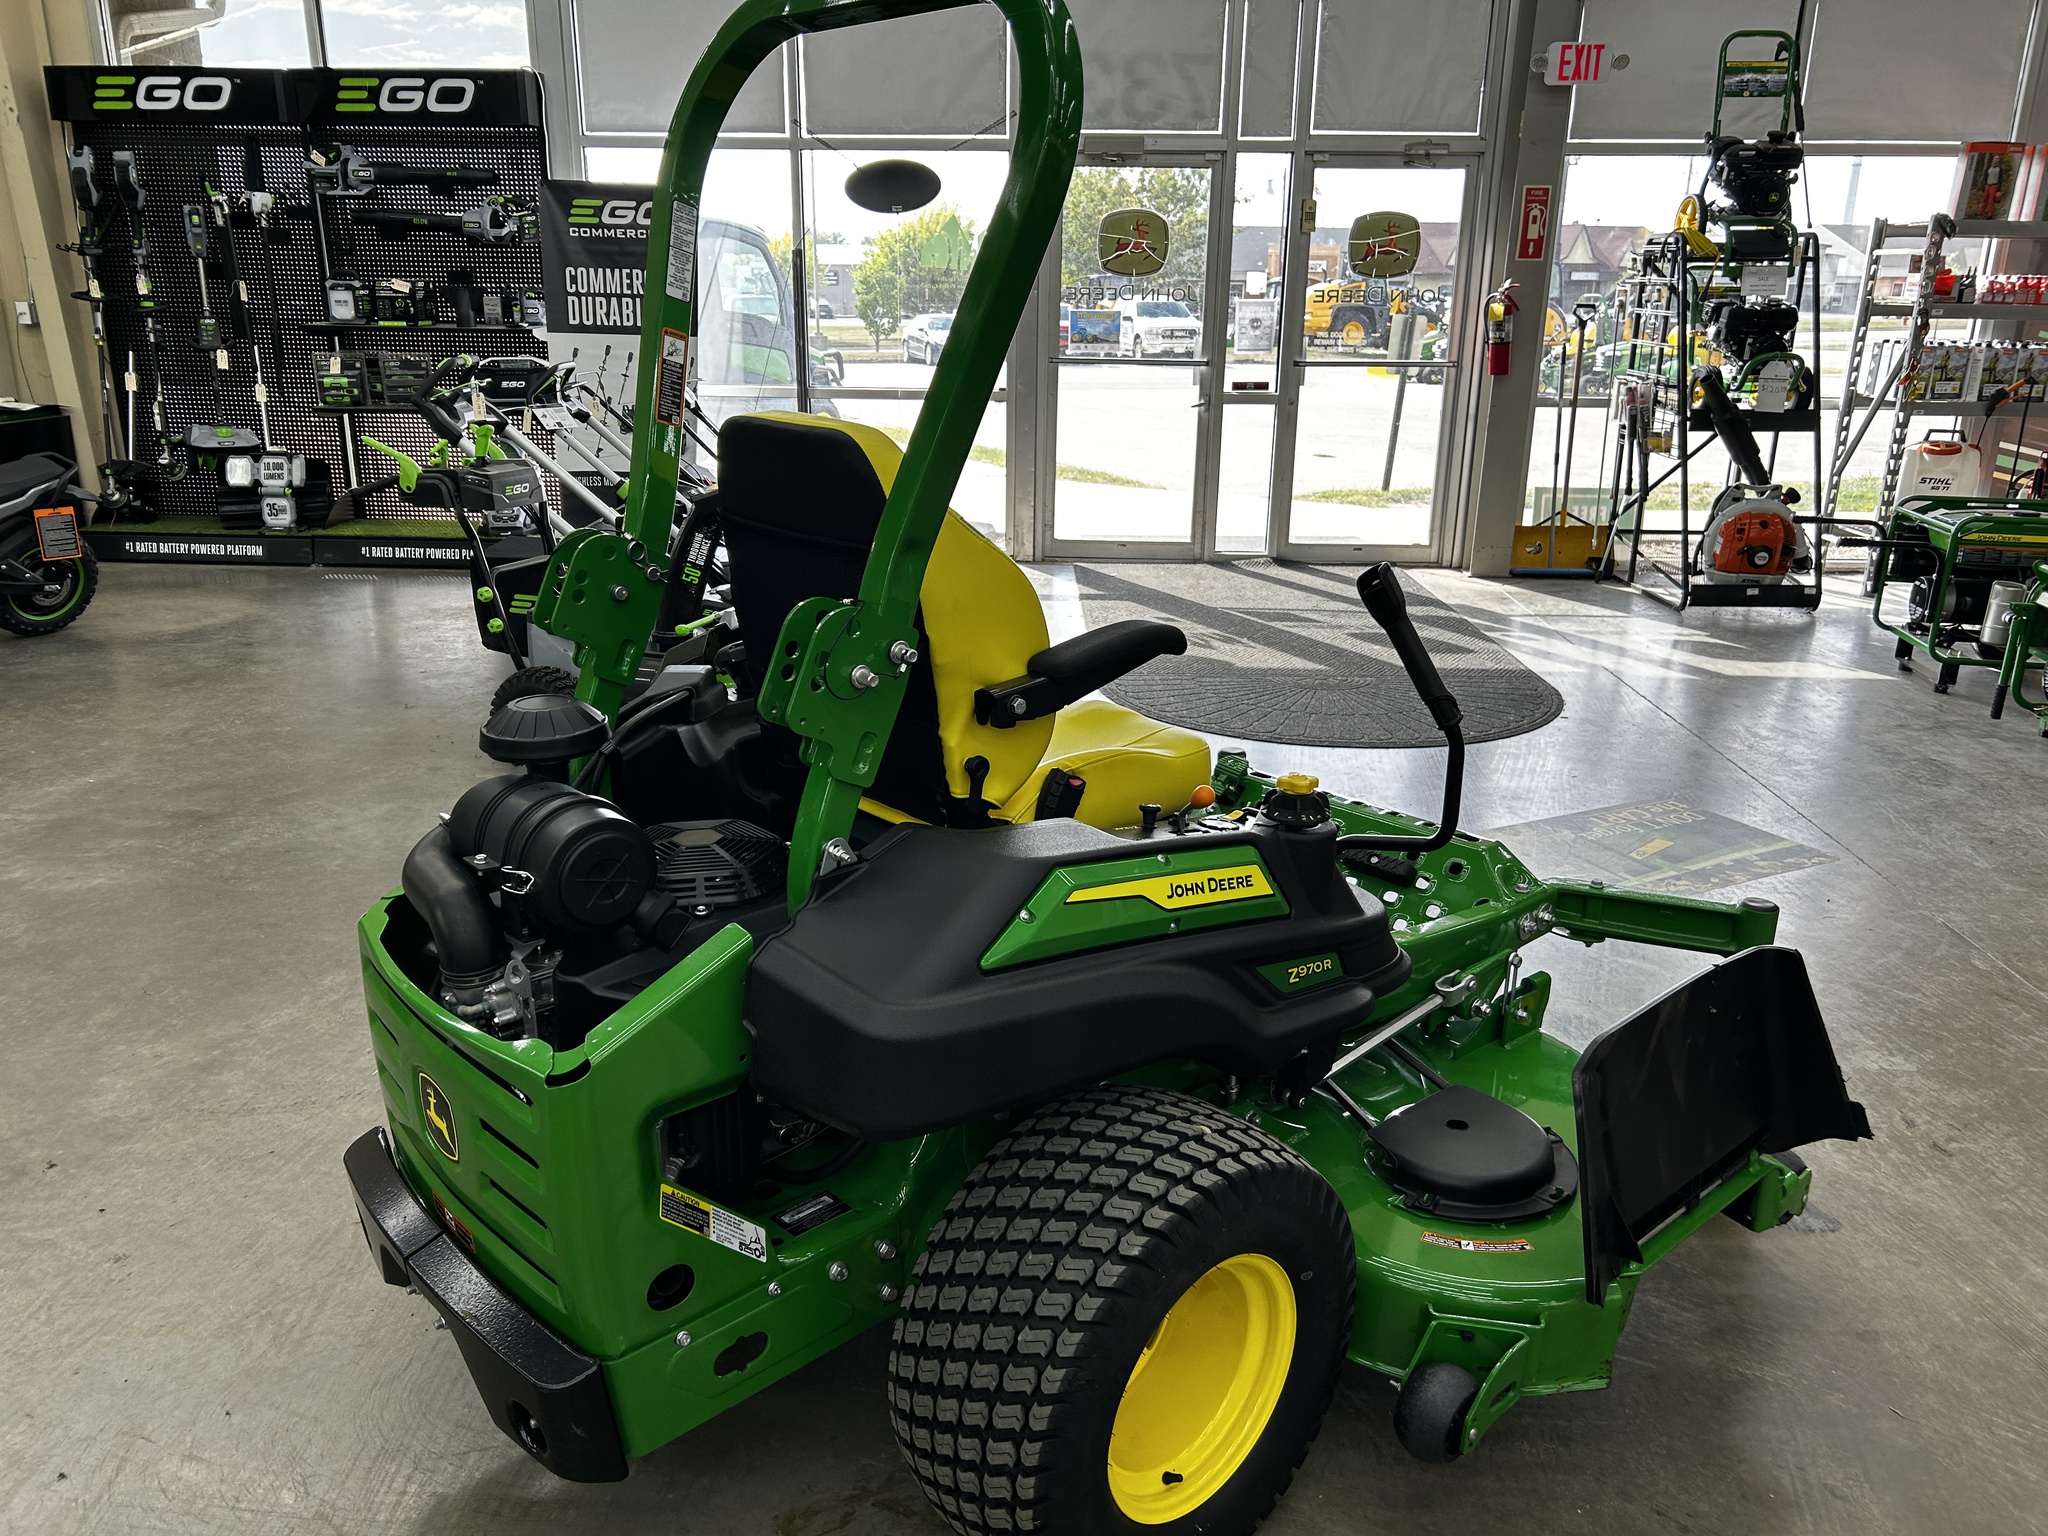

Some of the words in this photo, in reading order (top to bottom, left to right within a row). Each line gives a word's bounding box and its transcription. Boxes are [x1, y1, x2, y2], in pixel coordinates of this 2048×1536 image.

[1557, 44, 1605, 81] EXIT
[93, 76, 232, 110] EGO
[335, 78, 475, 112] EGO
[263, 462, 284, 471] 10,000
[505, 482, 529, 496] EGO
[1919, 477, 1952, 485] STIHL
[266, 503, 278, 517] 35
[1997, 534, 2022, 542] DEERE
[125, 541, 134, 552] #1
[136, 541, 157, 553] RATED
[160, 543, 189, 554] BATTERY
[191, 543, 225, 555] POWERED
[227, 544, 263, 556] PLATFORM
[361, 546, 370, 557] #1
[372, 546, 393, 558] RATED
[395, 547, 424, 559] BATTERY
[426, 548, 460, 560] POWERED
[687, 532, 703, 562] THROWING
[696, 538, 711, 566] DISTANCE
[1646, 801, 1689, 816] the
[1589, 807, 1651, 827] CART
[1643, 811, 1706, 830] DON'T
[1578, 823, 1643, 841] forget
[1166, 878, 1205, 899] JOHN
[1207, 874, 1254, 893] DEERE
[676, 1192, 701, 1207] CAUTION
